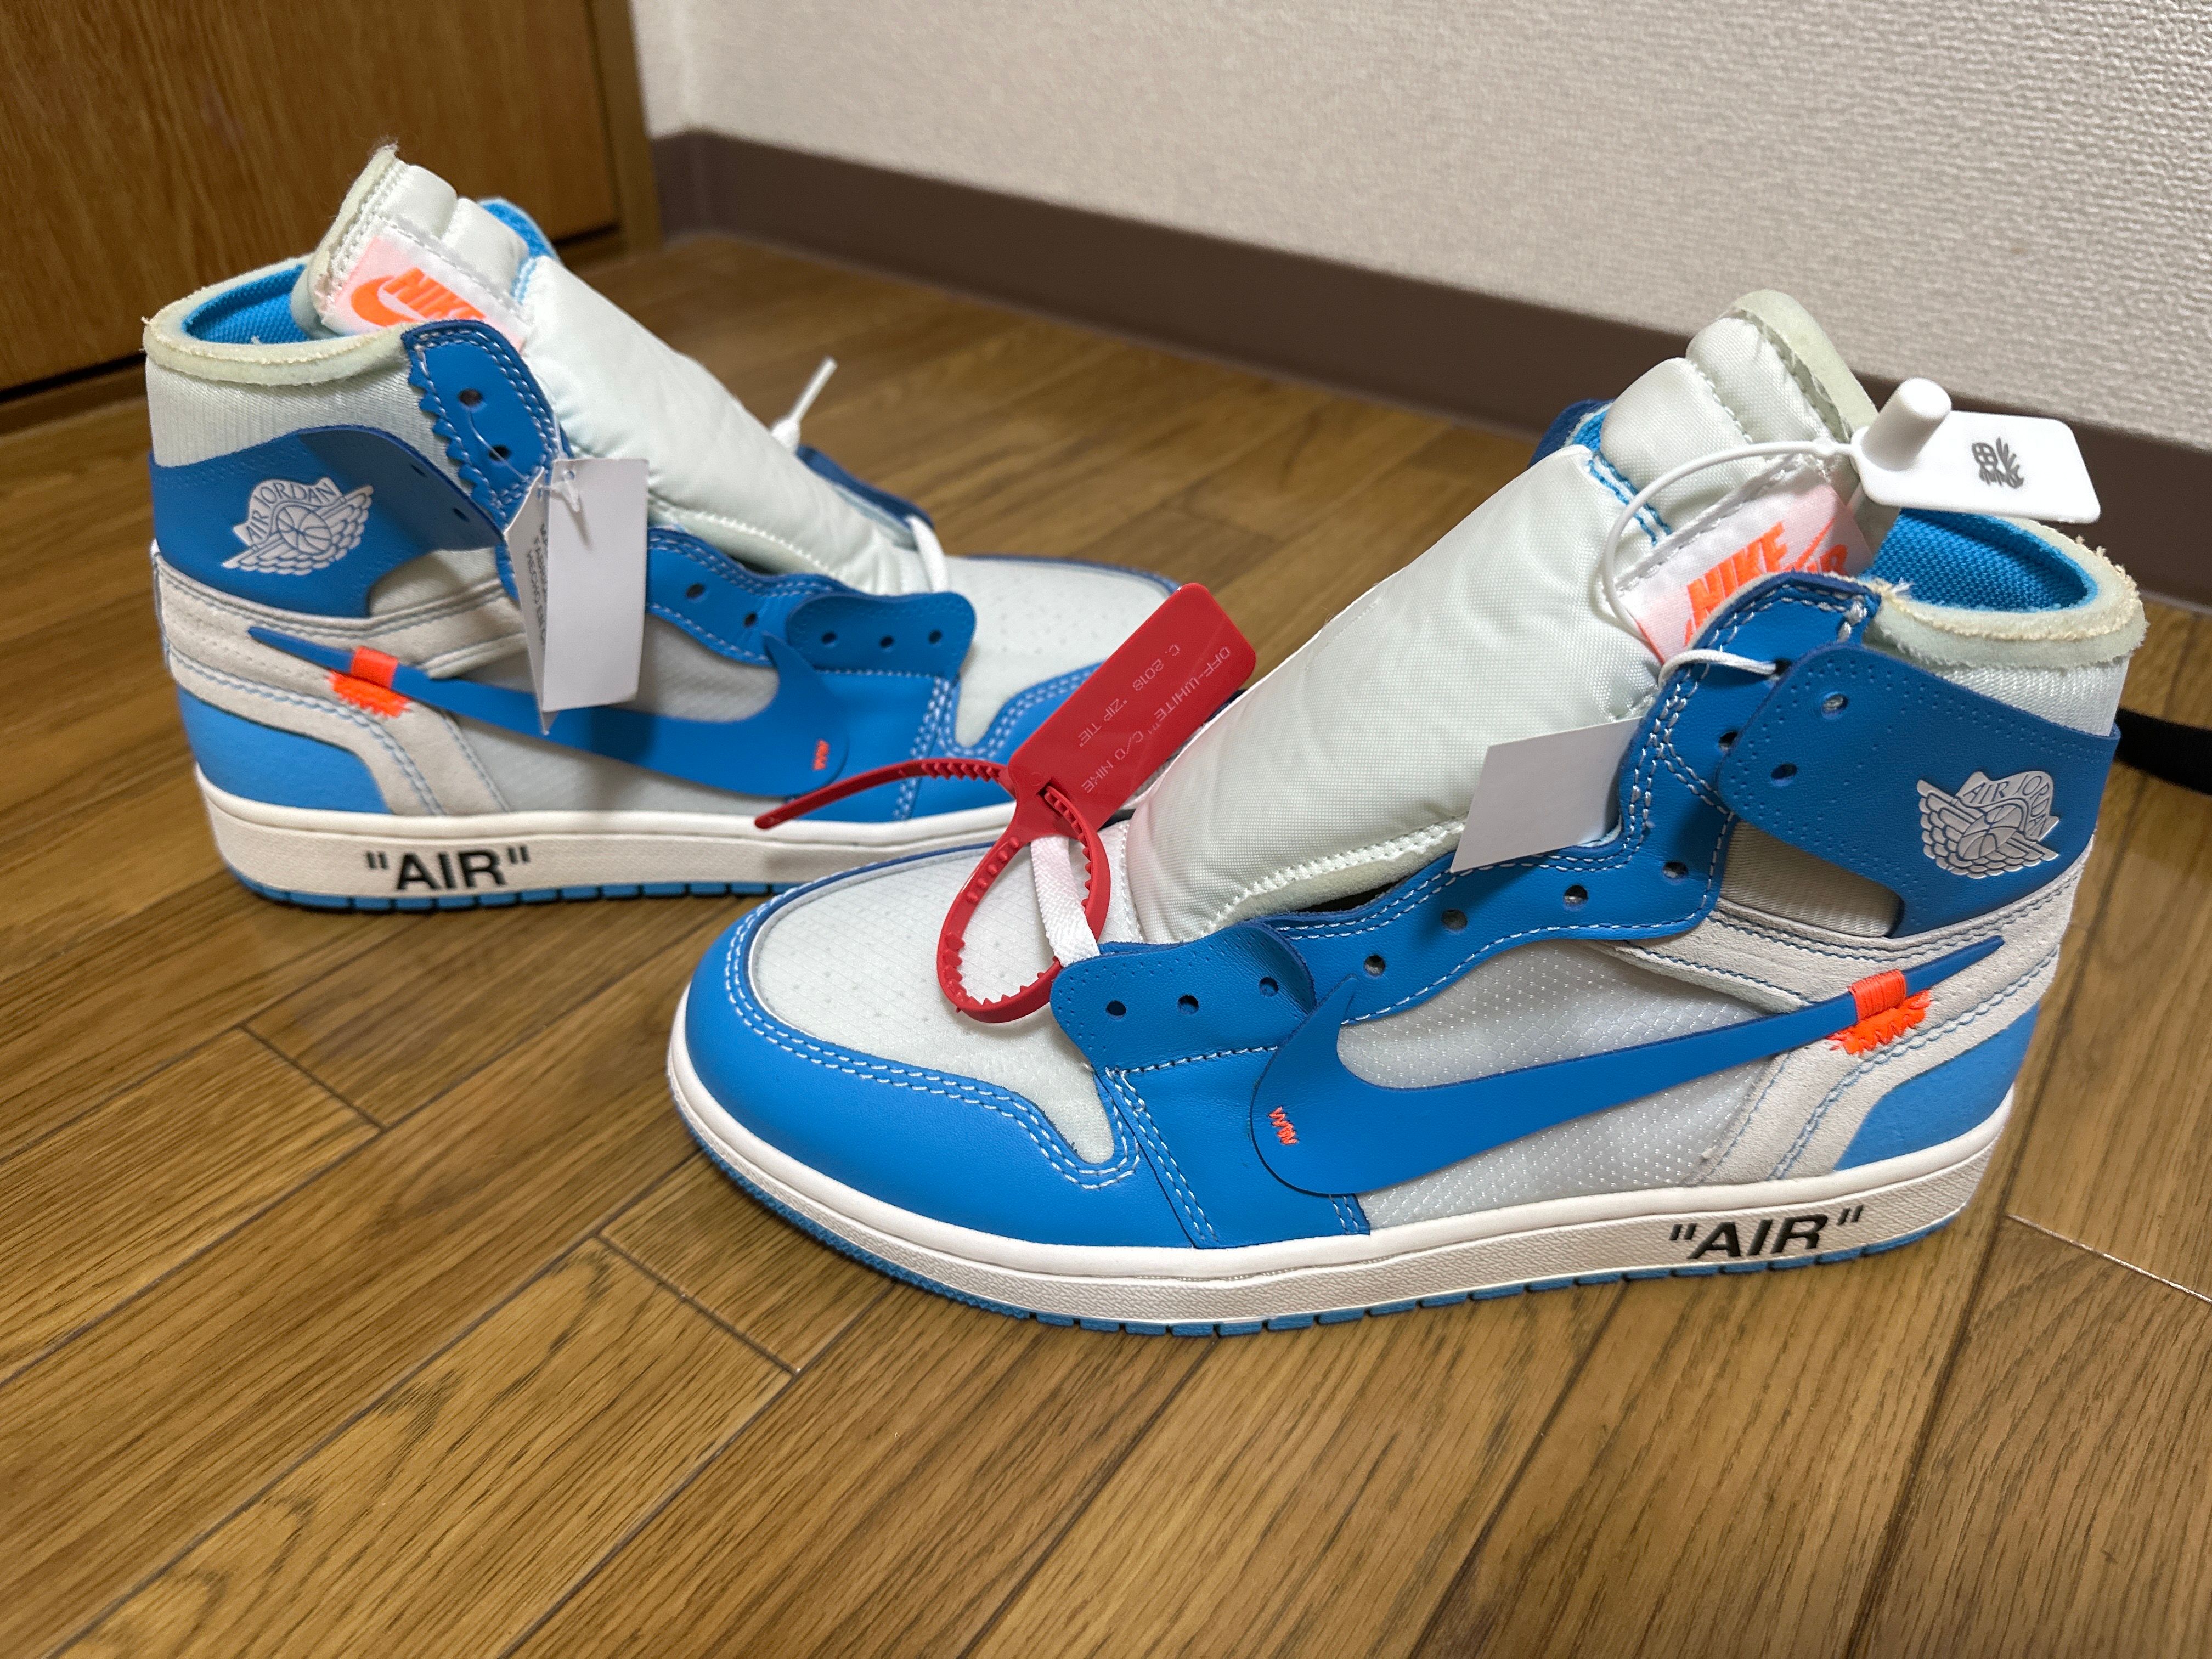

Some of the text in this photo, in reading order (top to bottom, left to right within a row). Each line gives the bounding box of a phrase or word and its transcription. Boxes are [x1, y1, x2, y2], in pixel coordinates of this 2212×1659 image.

[246, 482, 337, 541] AIR JORDAN
[1132, 658, 1165, 692] 2018
[1103, 698, 1128, 723] "ZIP
[1078, 722, 1103, 748] TIE"
[1115, 730, 1144, 762] C/O
[1080, 759, 1114, 794] NIKE
[1962, 773, 2050, 837] AIR JORDAN
[364, 844, 531, 891] "AIR"
[1668, 1204, 1865, 1260] "AIR"
